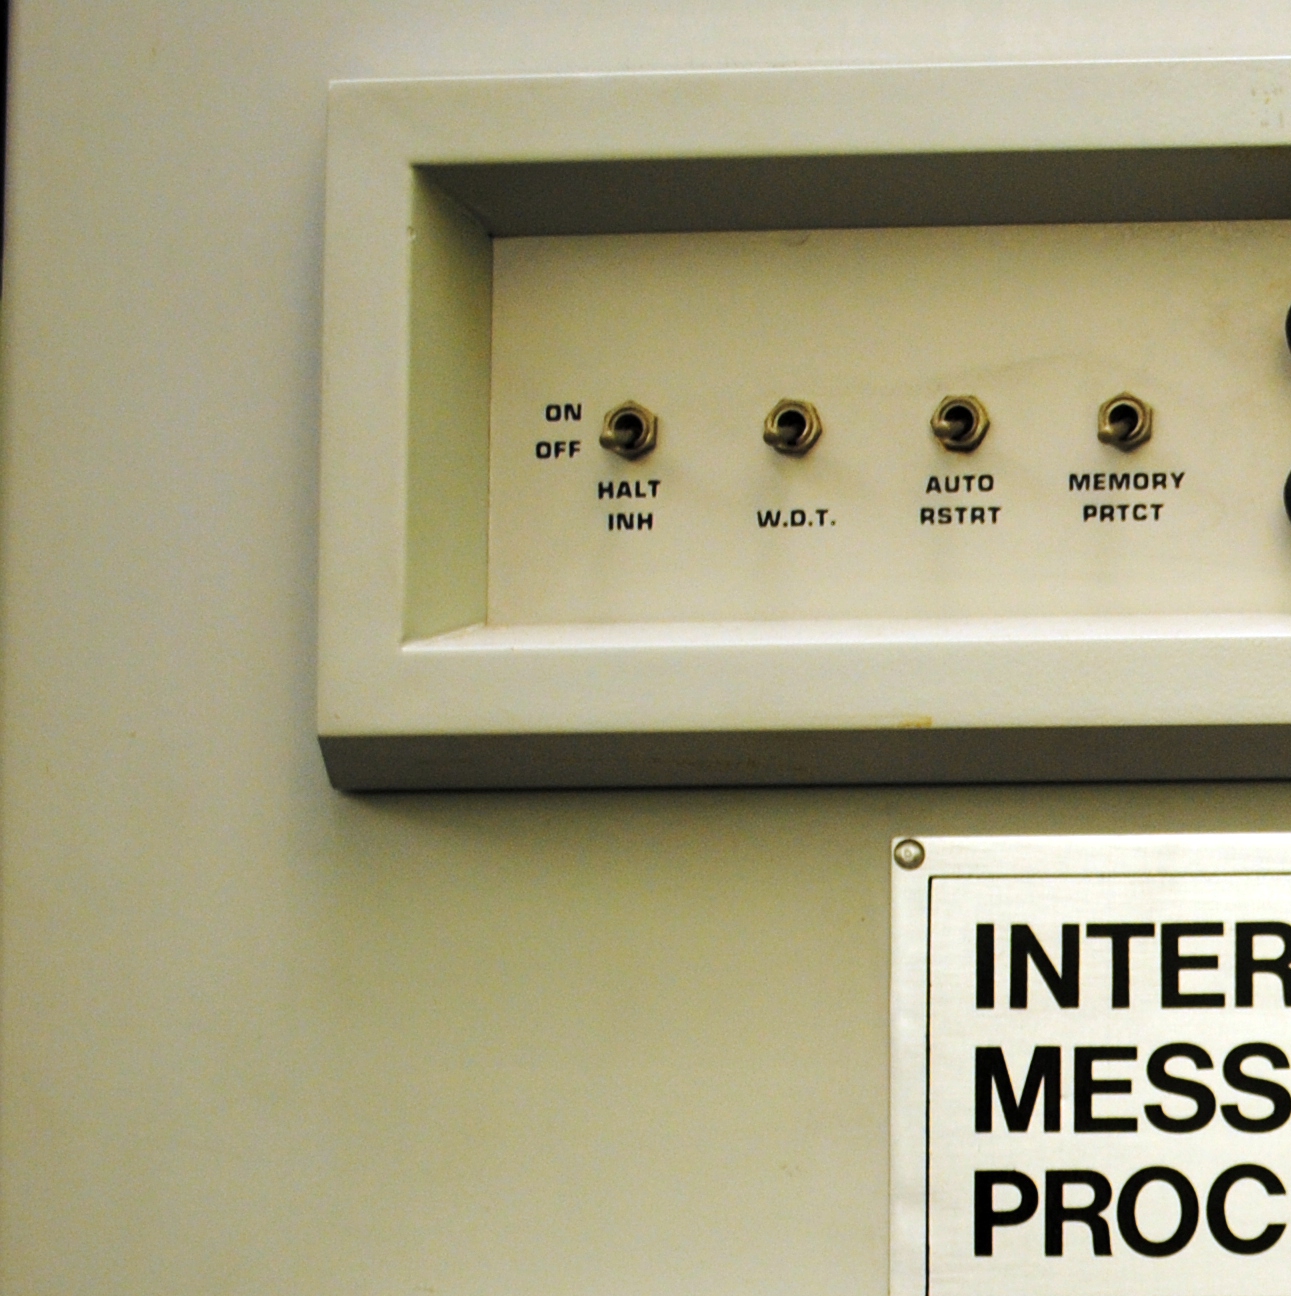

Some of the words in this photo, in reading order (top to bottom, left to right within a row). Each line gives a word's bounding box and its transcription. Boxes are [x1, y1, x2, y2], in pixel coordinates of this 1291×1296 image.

[545, 403, 582, 422] ON
[536, 440, 580, 459] OFF
[598, 480, 660, 499] HALT
[926, 474, 994, 494] AUTO
[1069, 472, 1184, 491] MEMORY
[608, 513, 653, 531] INH
[757, 509, 835, 528] W.D.T.
[920, 506, 1001, 525] RSTRT
[1083, 504, 1163, 522] PRTCT
